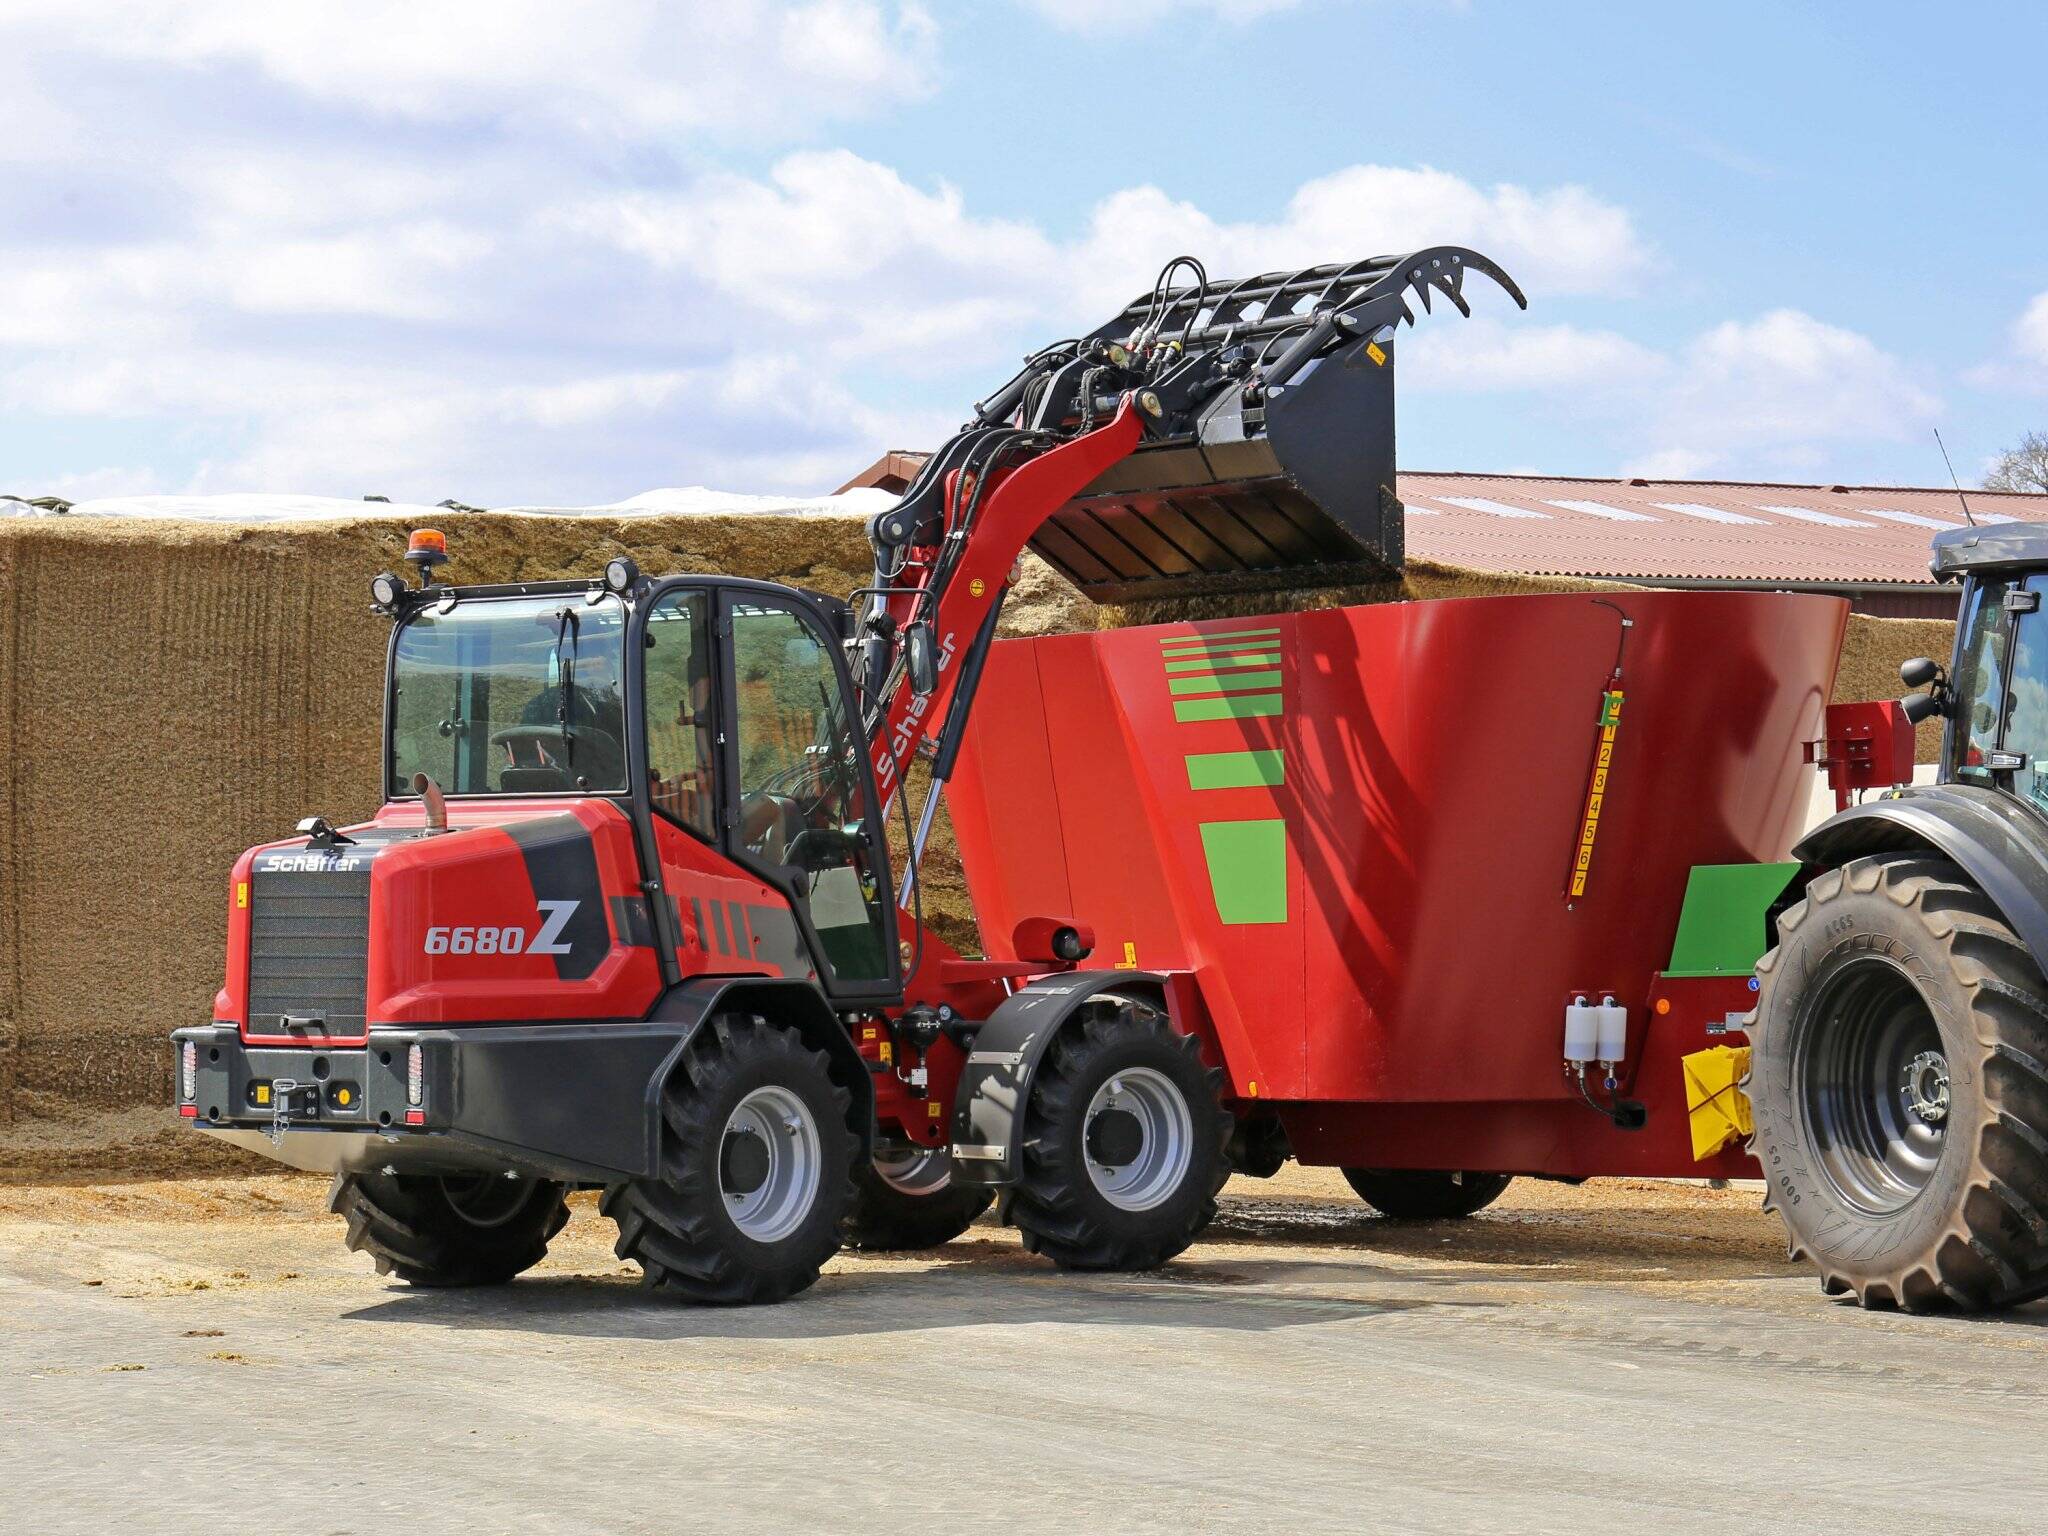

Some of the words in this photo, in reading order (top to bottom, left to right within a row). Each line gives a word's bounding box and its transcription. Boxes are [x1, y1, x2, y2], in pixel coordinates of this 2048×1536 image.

[876, 632, 957, 789] Schäer
[1607, 724, 1613, 737] 1
[1600, 748, 1609, 762] 2
[1595, 774, 1605, 788] 3
[1590, 799, 1599, 814] 4
[1585, 825, 1594, 840] 5
[1579, 851, 1589, 865] 6
[1575, 877, 1584, 891] 7
